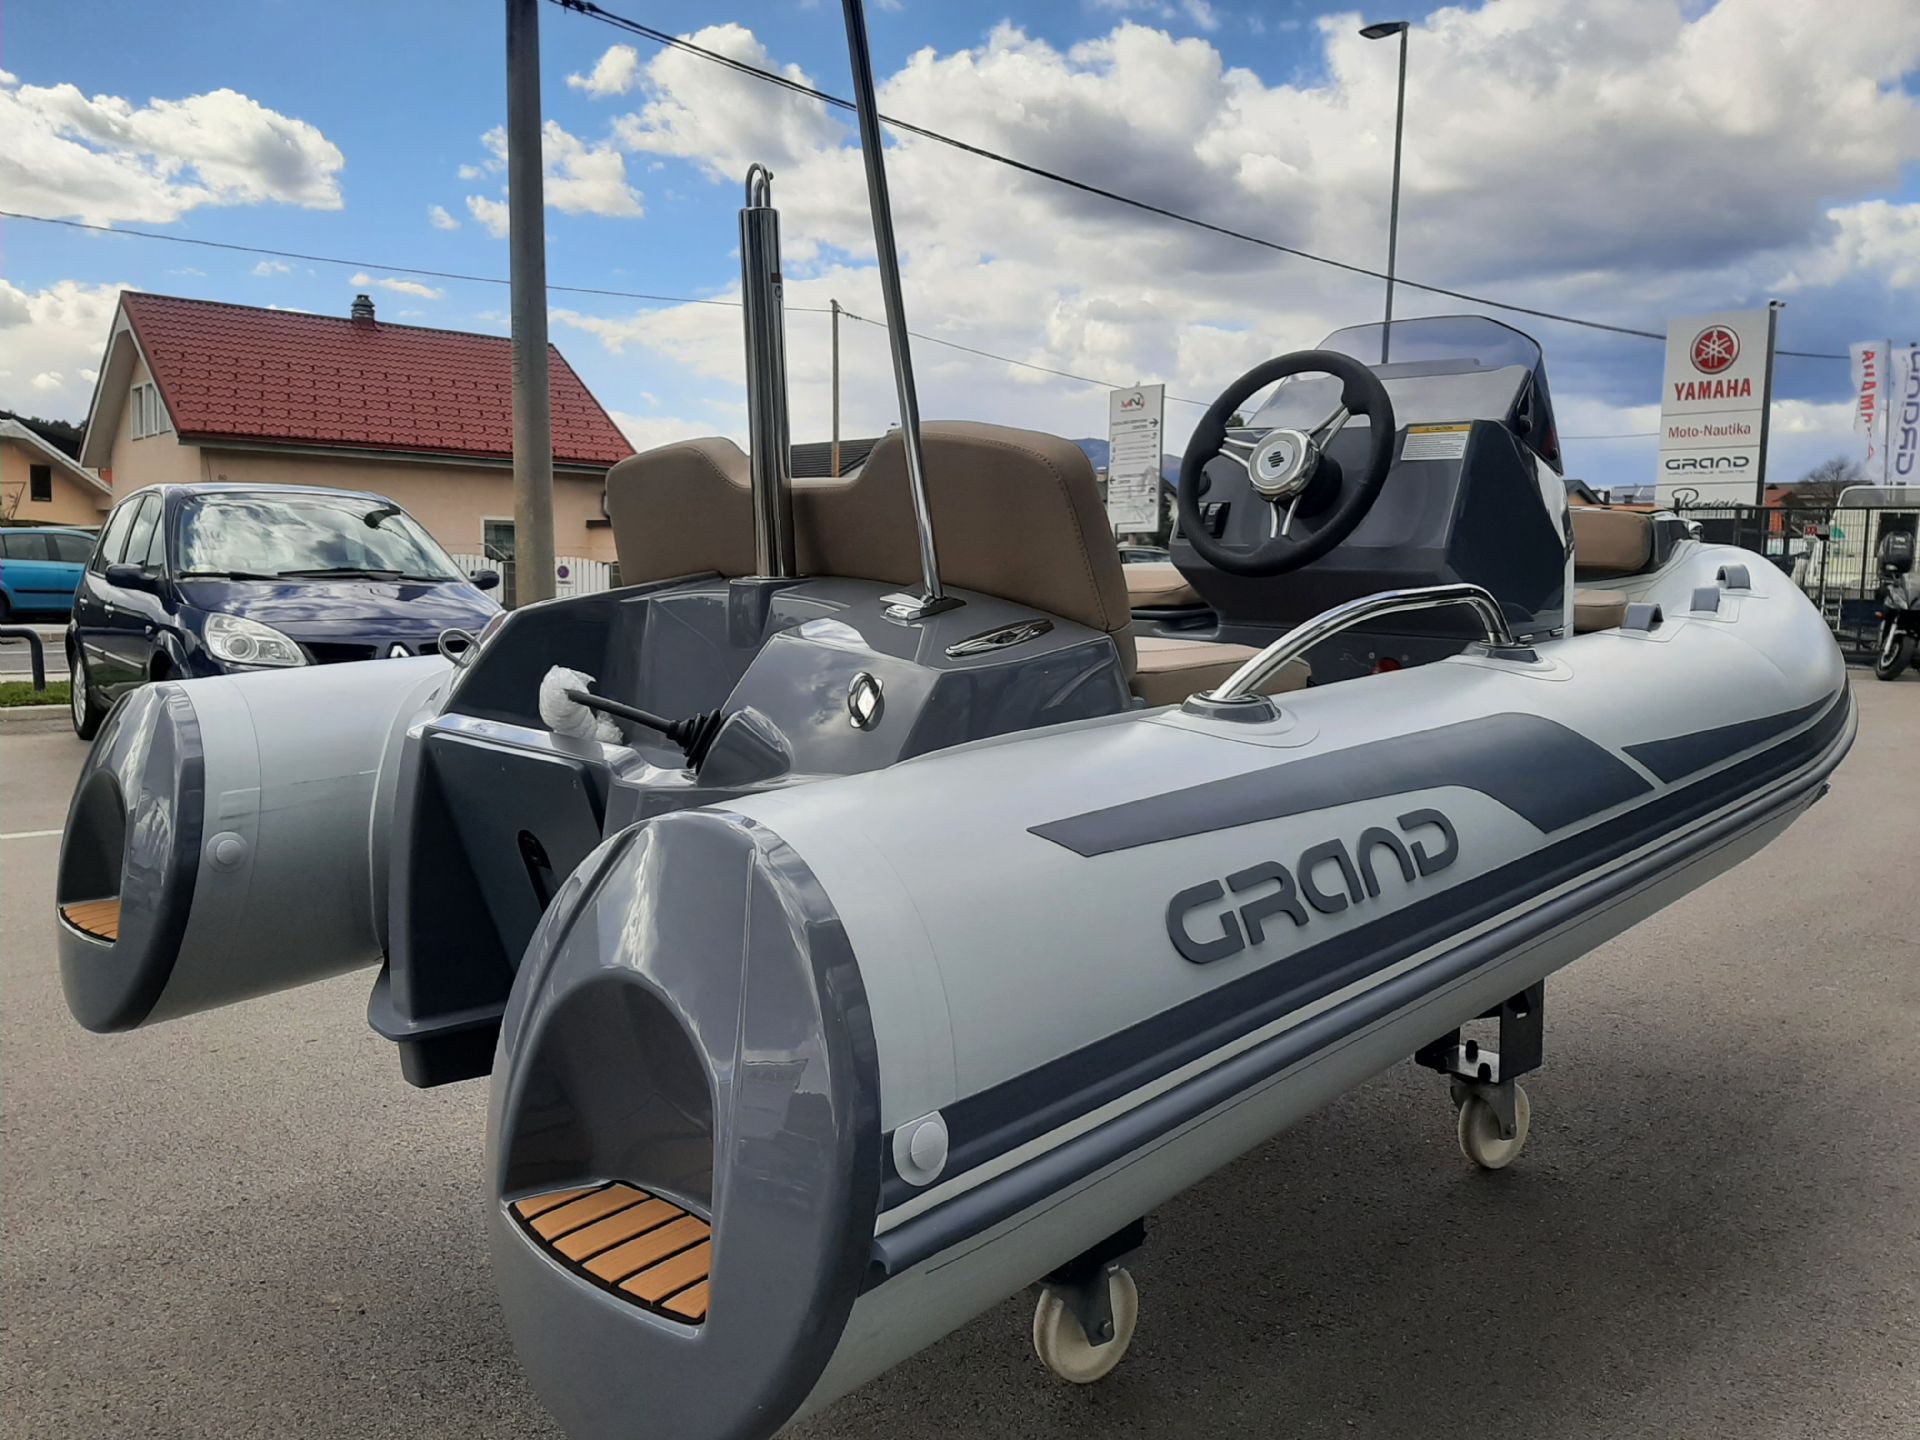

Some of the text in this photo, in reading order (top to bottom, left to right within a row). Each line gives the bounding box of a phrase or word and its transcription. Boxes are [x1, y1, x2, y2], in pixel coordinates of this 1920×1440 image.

[1674, 377, 1751, 401] YAMAHA
[1668, 423, 1751, 439] Moto-Nautika
[1665, 456, 1750, 470] GRAND
[1165, 807, 1459, 965] GRAND
